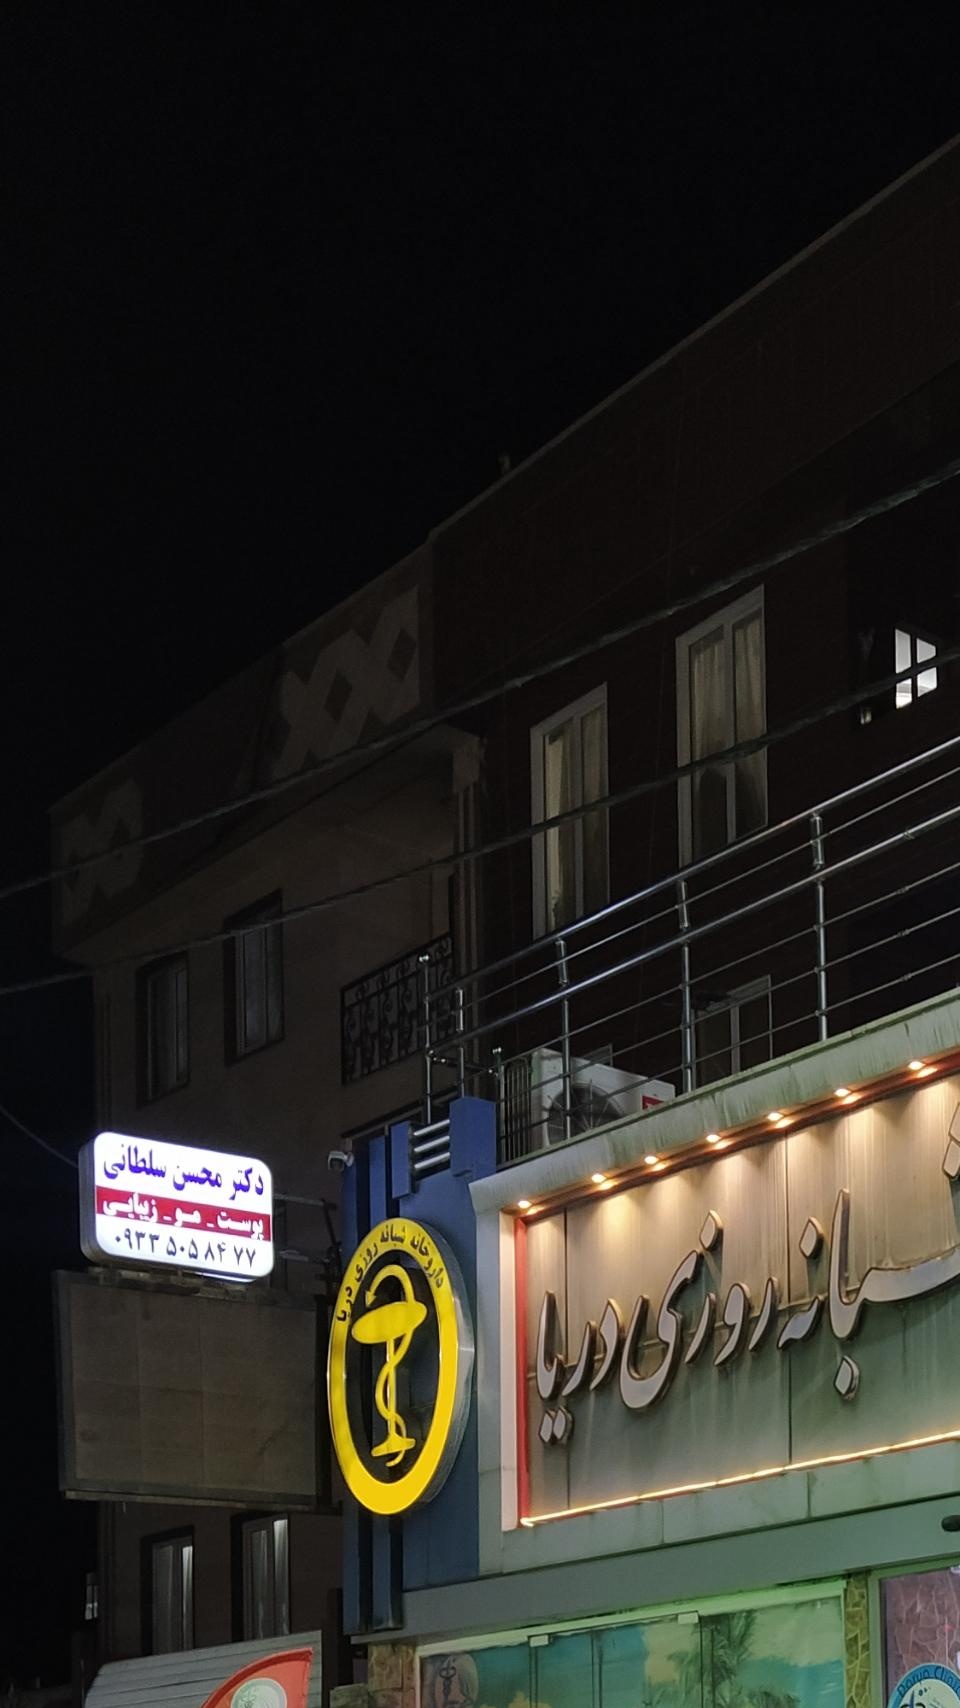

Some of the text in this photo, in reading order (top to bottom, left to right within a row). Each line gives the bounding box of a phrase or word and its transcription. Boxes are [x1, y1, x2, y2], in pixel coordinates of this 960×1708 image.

[103, 1143, 265, 1201] دکتر محسن سلطانی
[102, 1192, 159, 1224] زیبایی
[173, 1206, 202, 1227] مو
[216, 1210, 264, 1240] پوست
[336, 1223, 444, 1322] داروخانه شبانه روزی دریا
[618, 1208, 782, 1412] روزی
[535, 1286, 625, 1446] دریا
